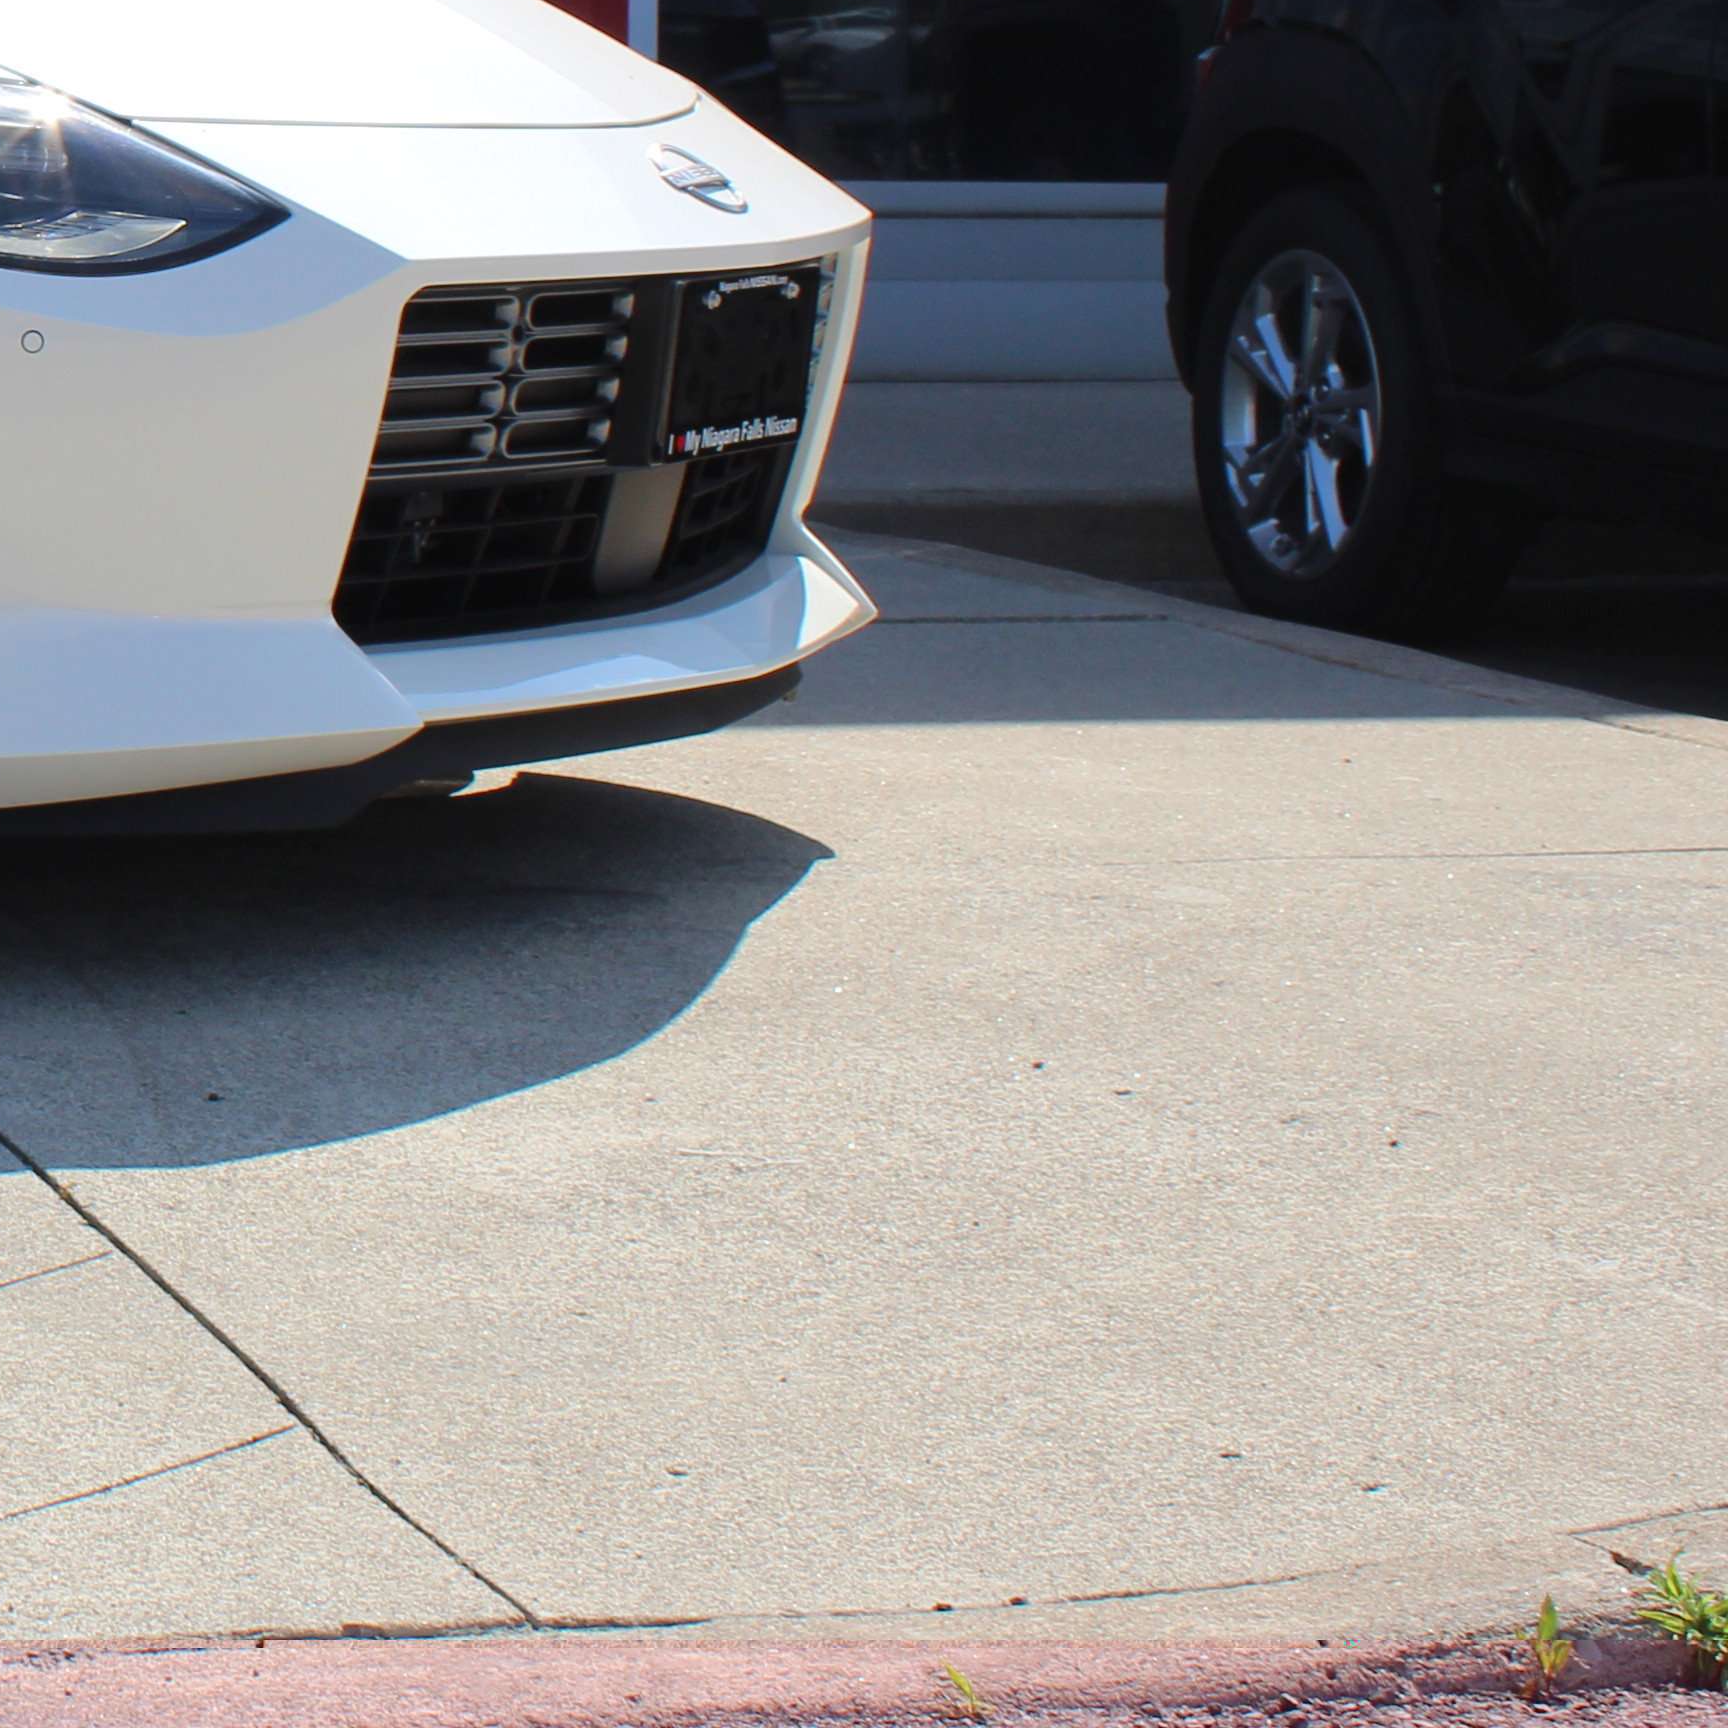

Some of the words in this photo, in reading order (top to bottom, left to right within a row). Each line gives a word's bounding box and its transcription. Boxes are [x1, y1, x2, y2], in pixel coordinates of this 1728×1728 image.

[668, 433, 675, 456] I
[684, 429, 702, 456] My
[700, 426, 741, 452] Niagara
[740, 417, 764, 441] Falls
[764, 415, 798, 437] Nissan
